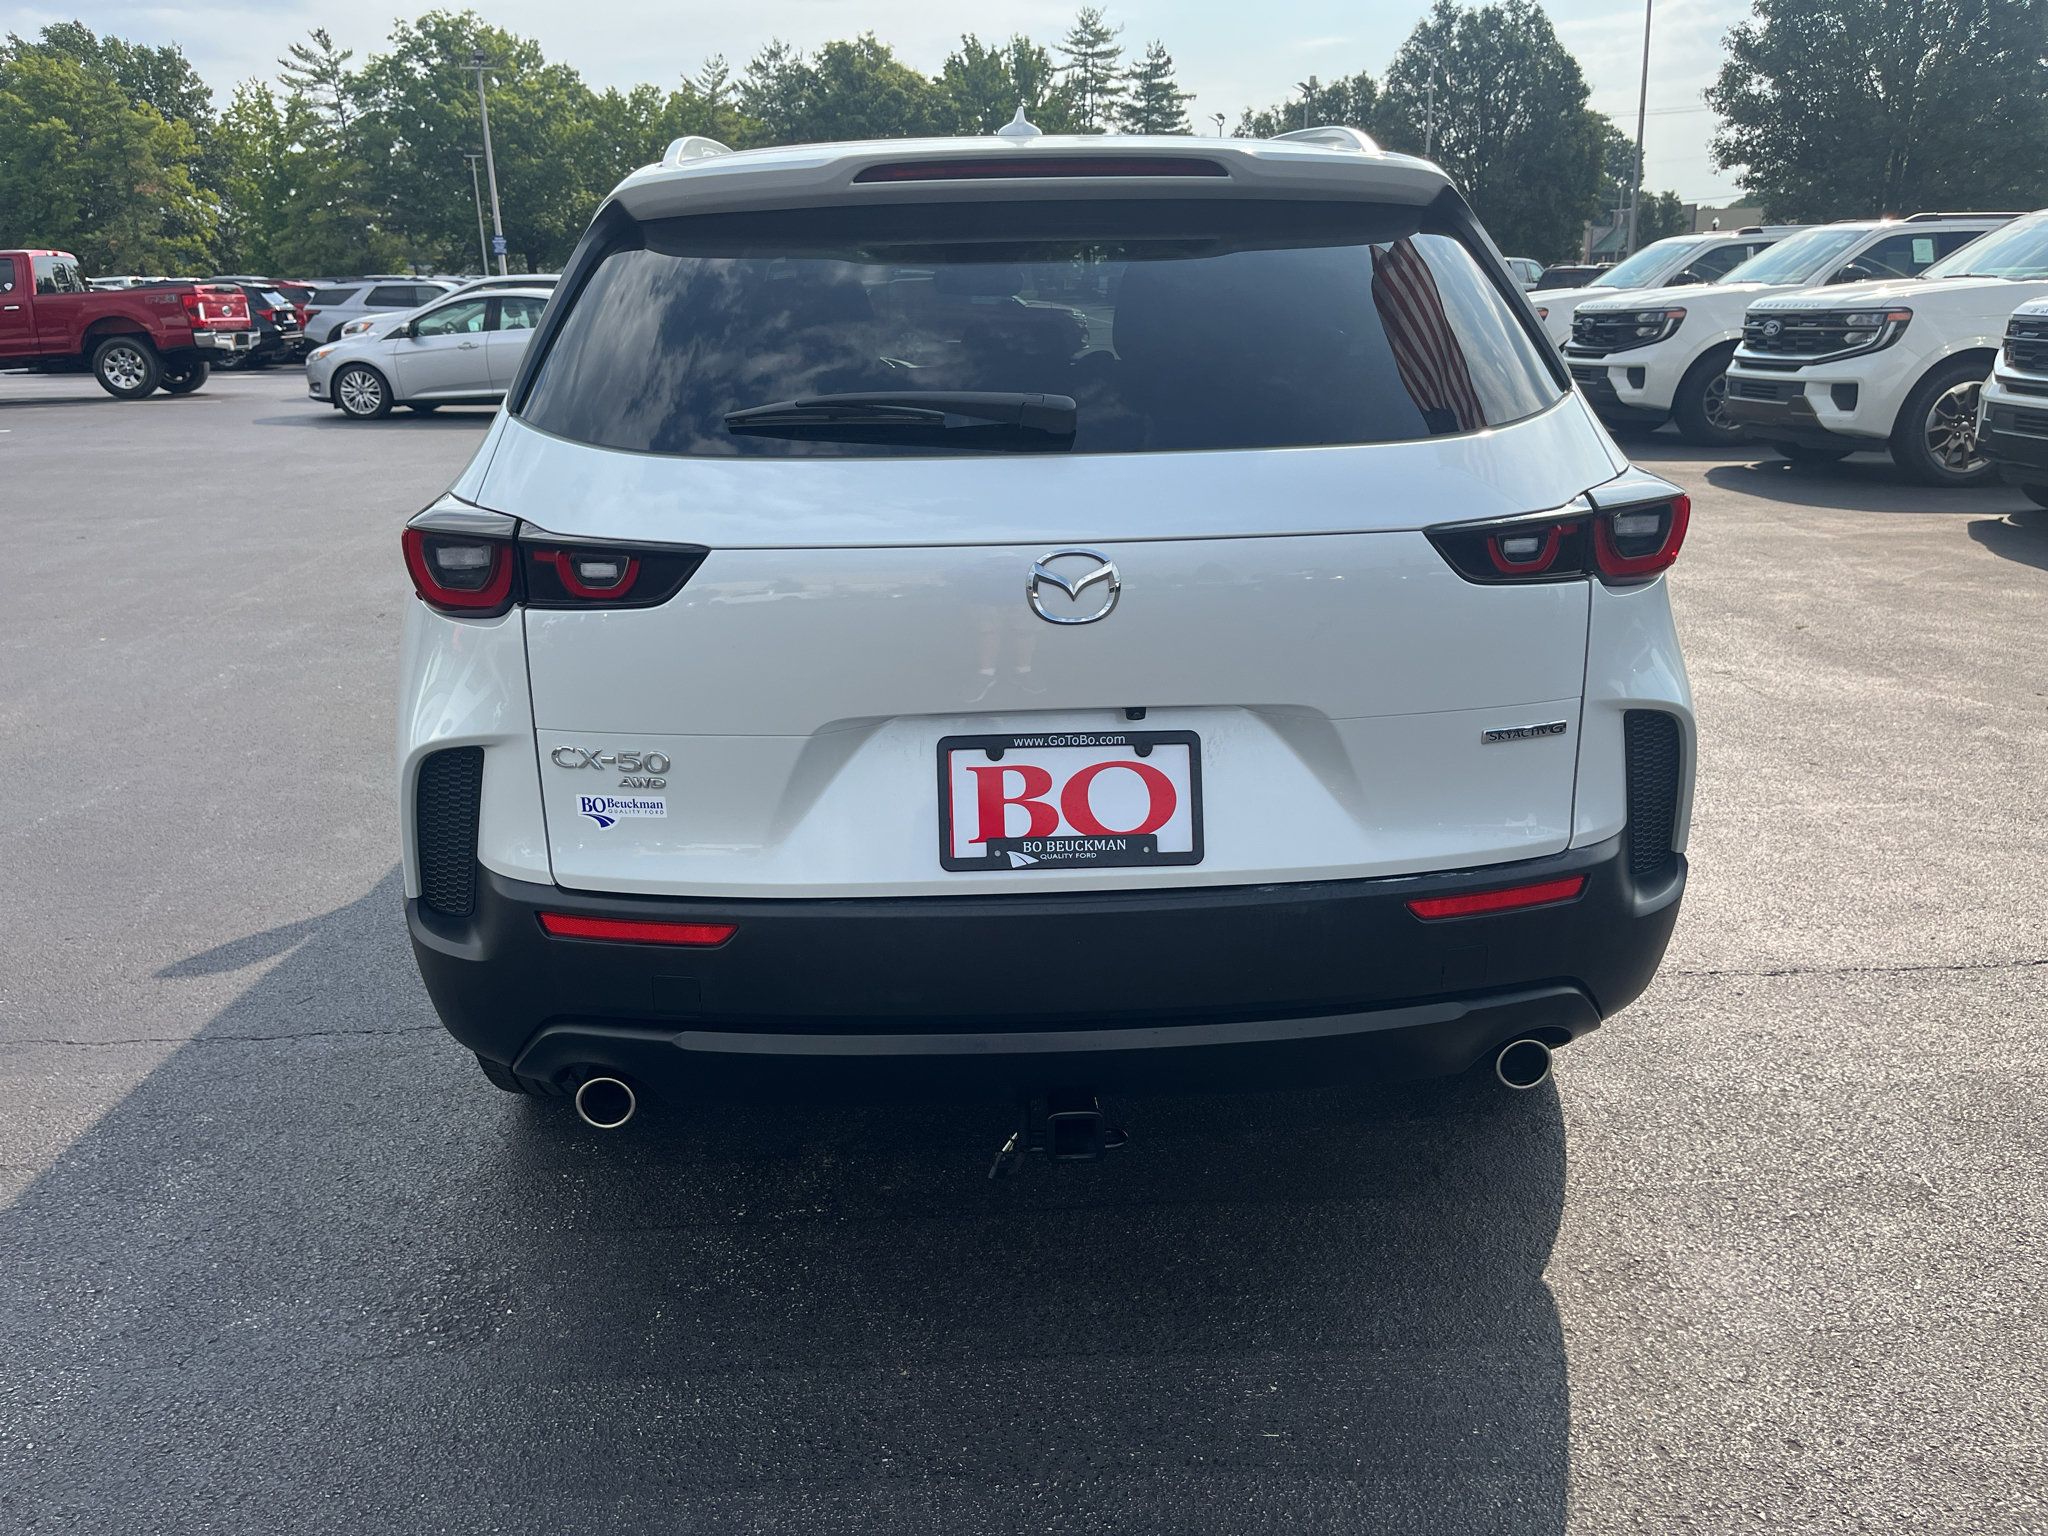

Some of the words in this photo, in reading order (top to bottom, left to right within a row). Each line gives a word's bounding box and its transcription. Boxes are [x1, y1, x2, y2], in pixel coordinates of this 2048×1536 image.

[1013, 734, 1126, 747] www.GoToBo.com
[551, 745, 671, 775] CX-50
[618, 776, 667, 789] AWD
[580, 796, 606, 813] BO
[607, 798, 664, 809] Beuckman
[966, 760, 1177, 844] BO
[1023, 841, 1042, 853] BO
[1046, 839, 1127, 852] BEUCKMAN
[1040, 853, 1074, 861] QUALITY
